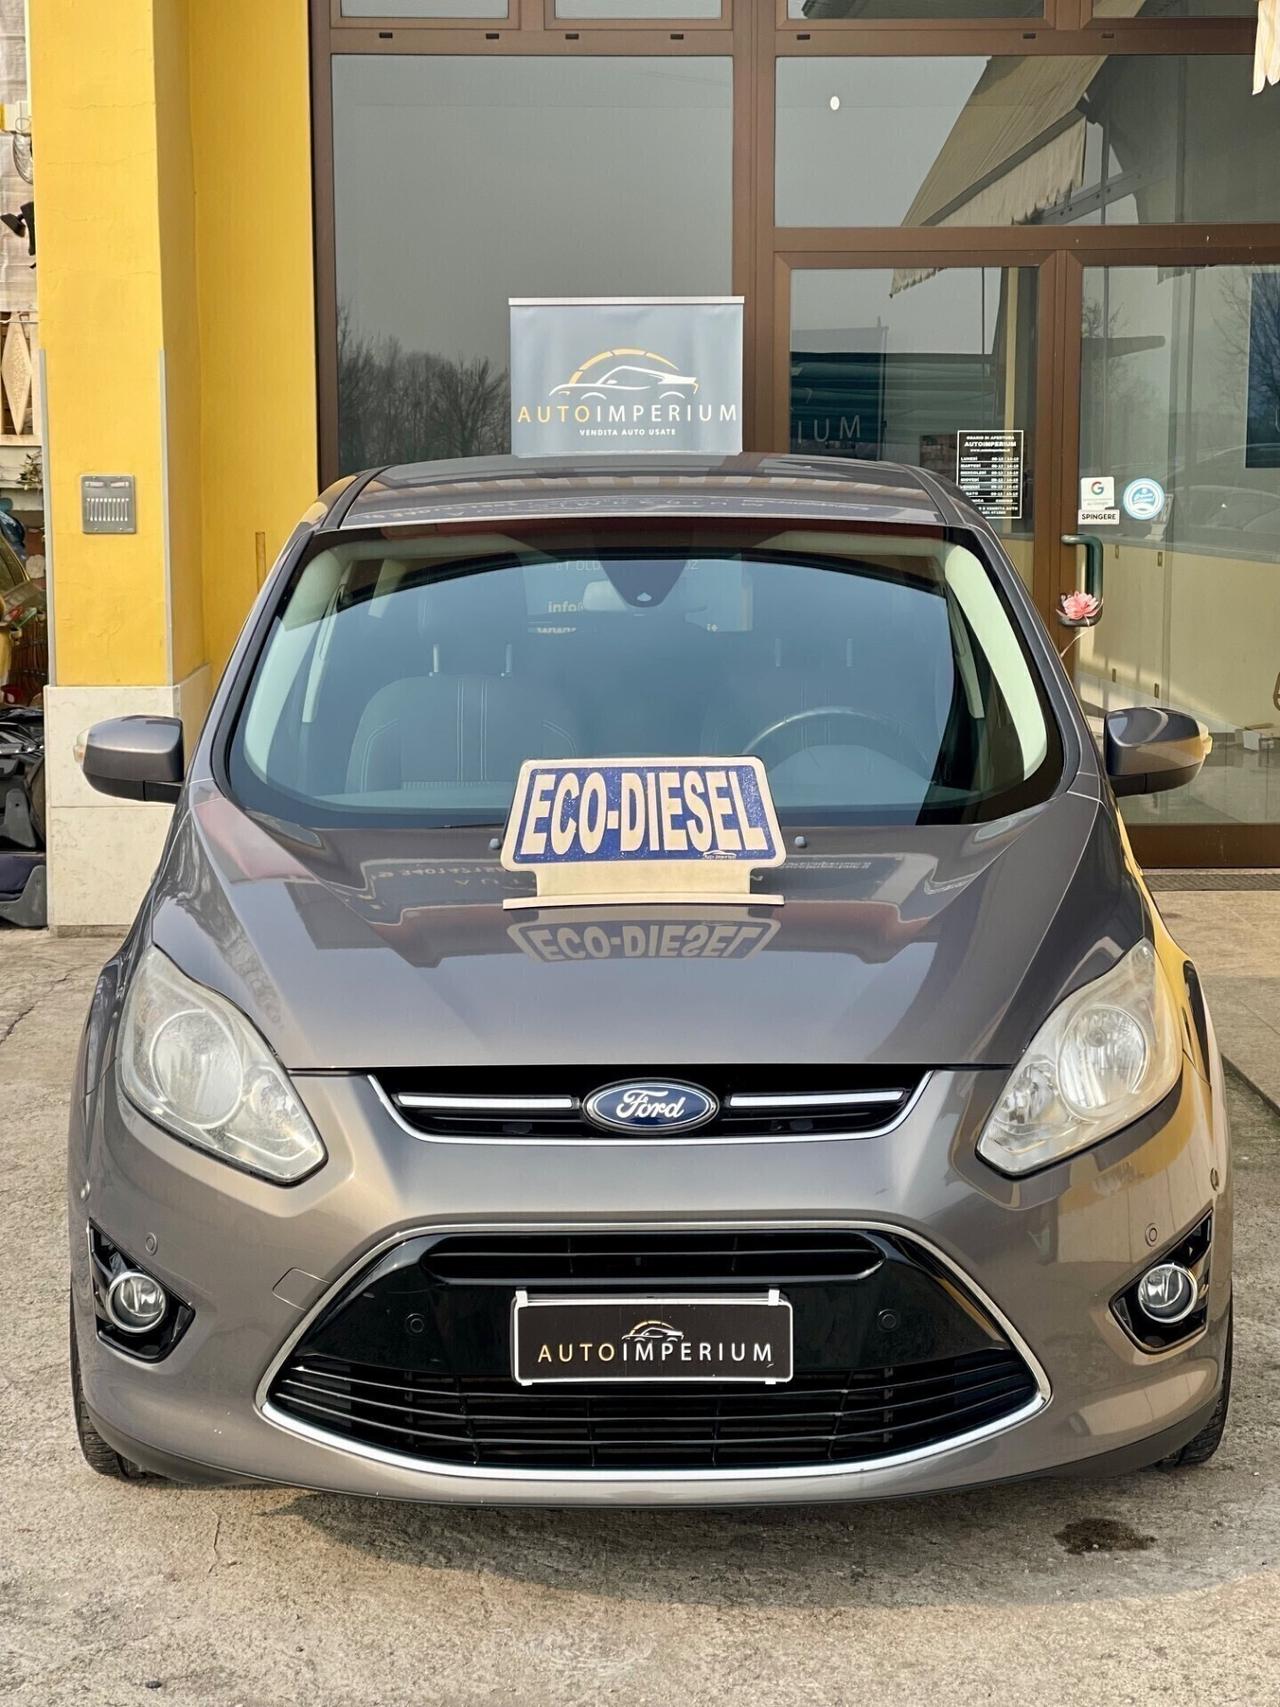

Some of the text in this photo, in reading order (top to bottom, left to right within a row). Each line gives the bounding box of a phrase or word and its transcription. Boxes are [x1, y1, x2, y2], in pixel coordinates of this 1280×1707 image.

[517, 404, 737, 423] AUTOIMPERIUM
[579, 429, 618, 437] VENDITA
[649, 428, 676, 436] USATE
[520, 770, 769, 855] ECO-DIESEL
[616, 1088, 686, 1119] Ford
[537, 1342, 773, 1363] AUTOIMPERIUM
